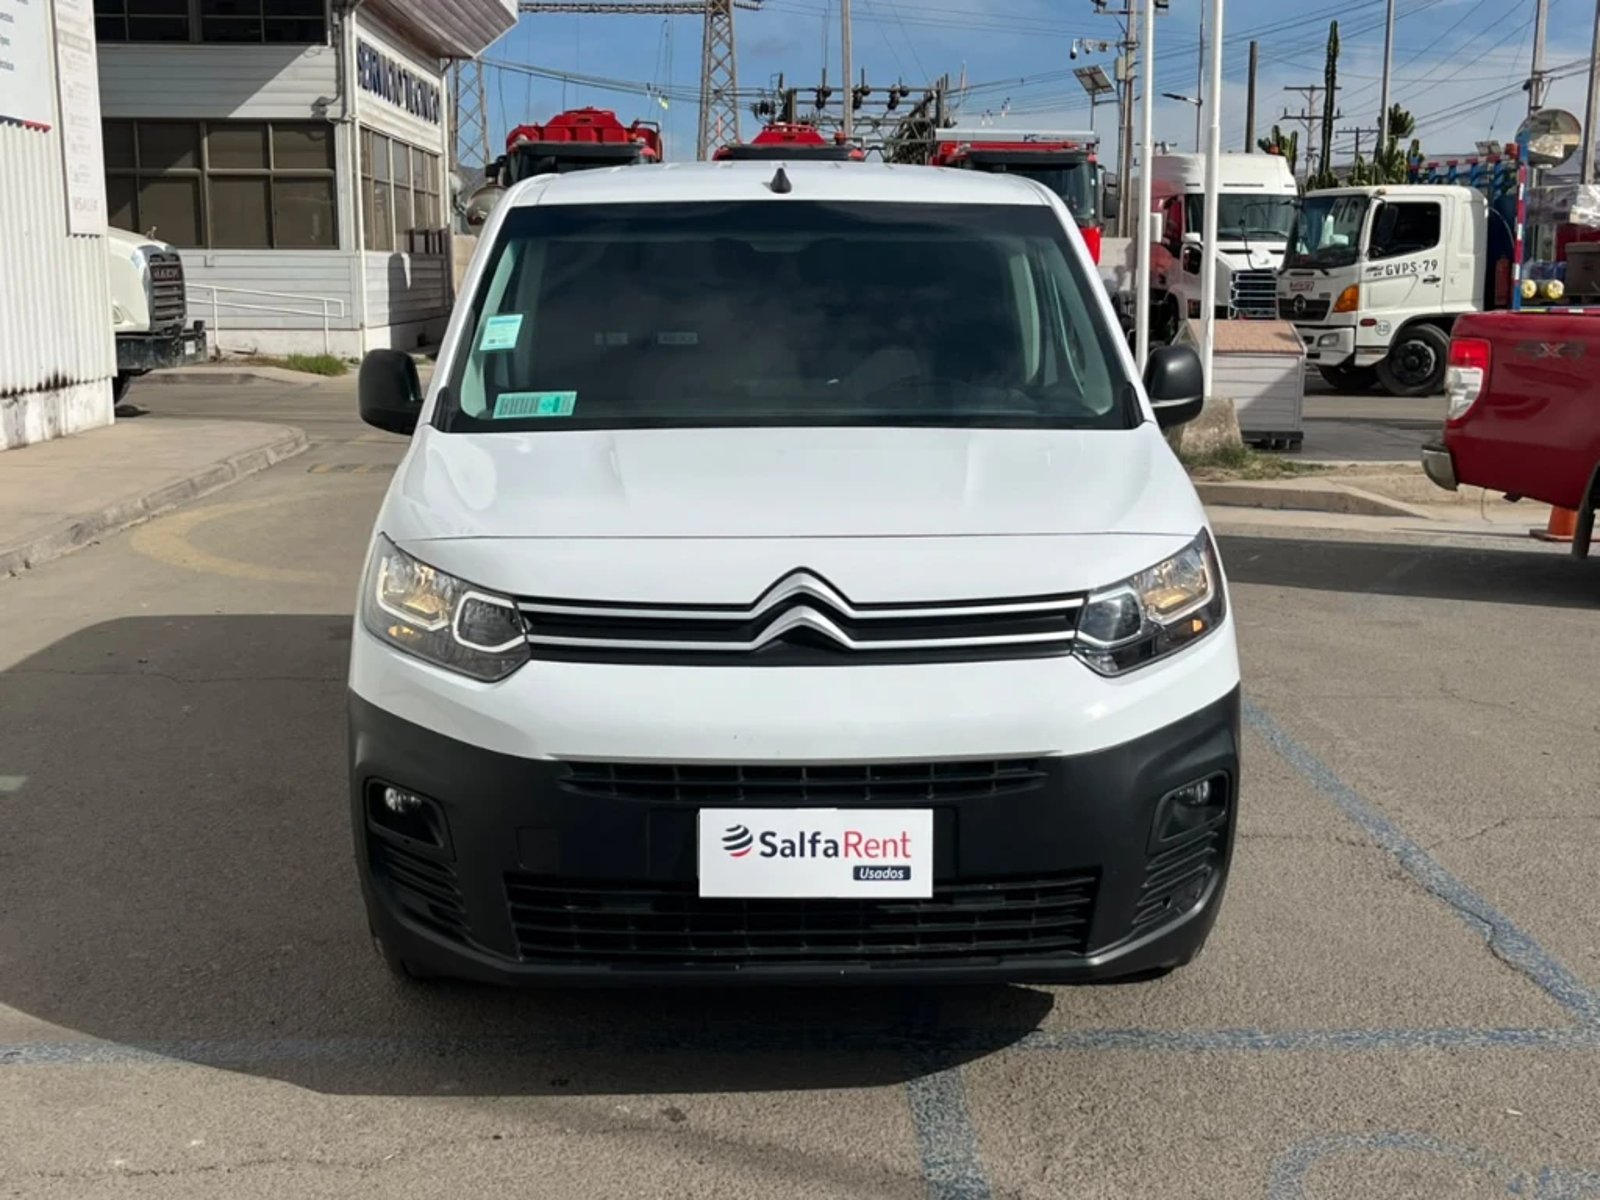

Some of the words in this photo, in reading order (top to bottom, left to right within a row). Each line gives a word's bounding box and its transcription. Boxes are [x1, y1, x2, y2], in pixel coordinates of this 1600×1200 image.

[1385, 259, 1438, 276] GVPS-79
[759, 830, 912, 858] SalfaRent
[859, 867, 904, 880] Usados
